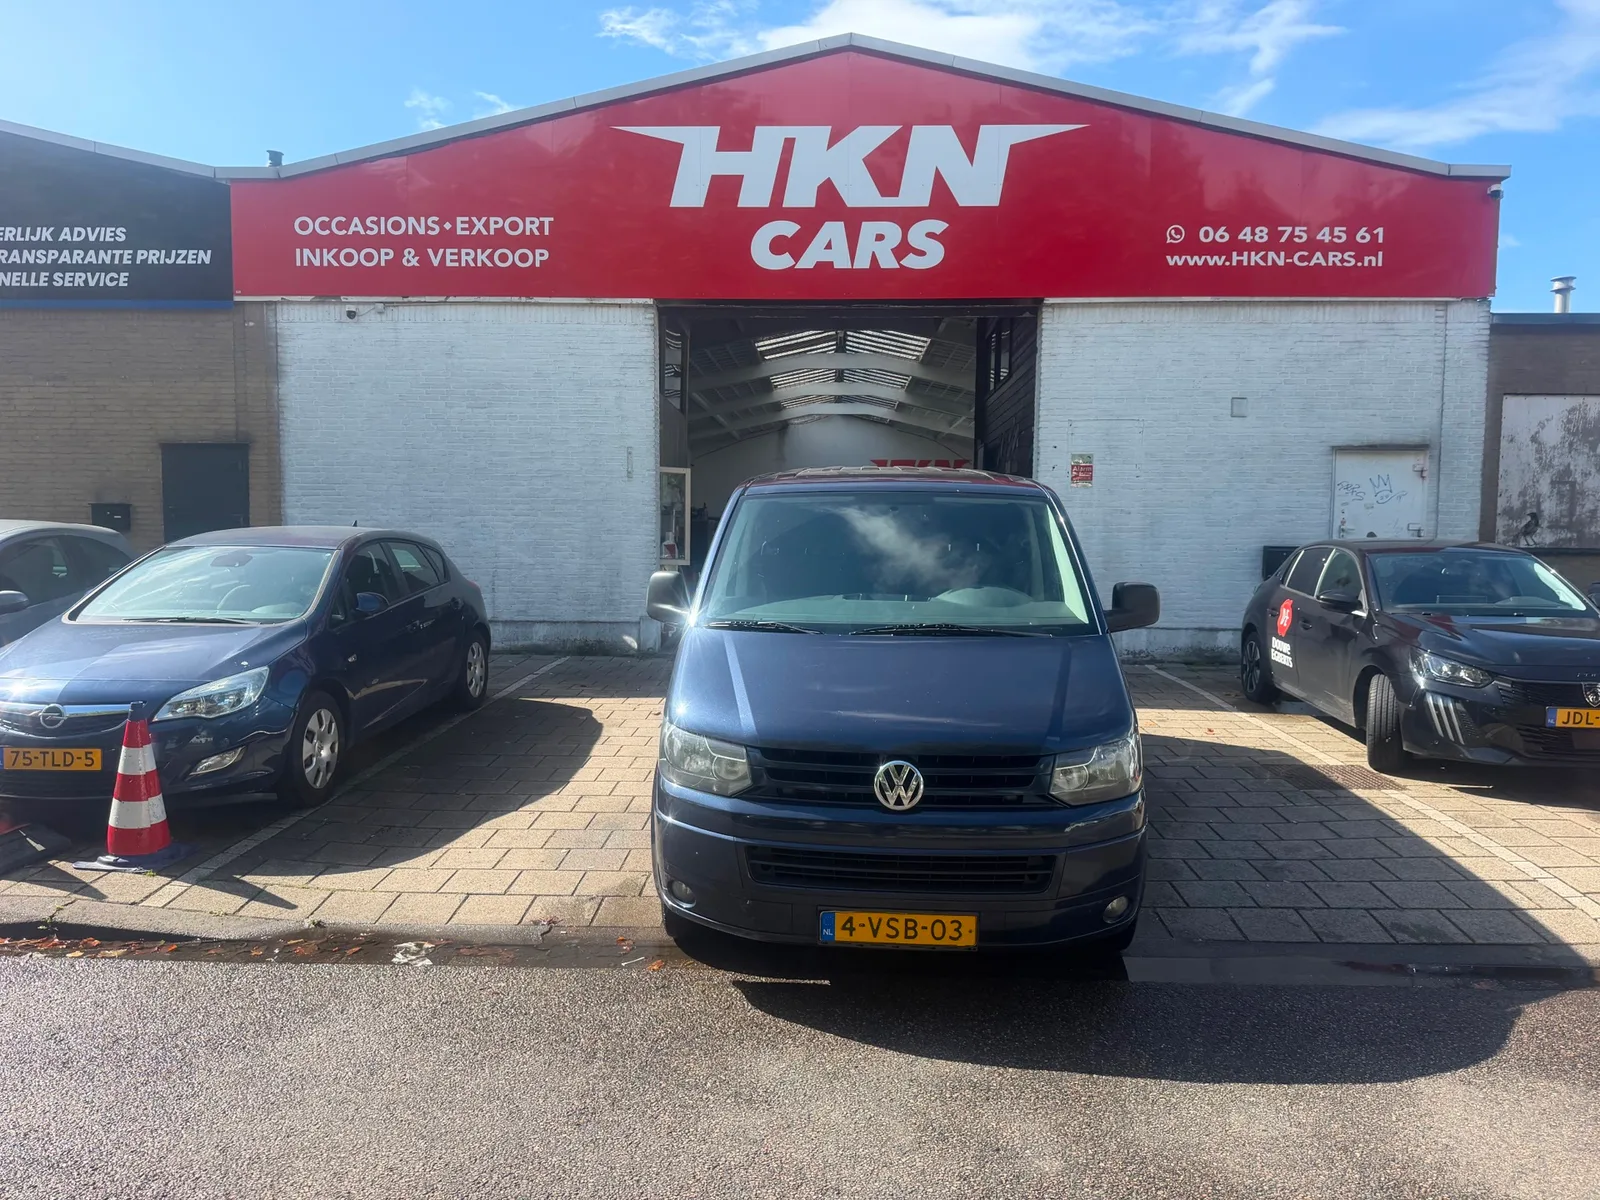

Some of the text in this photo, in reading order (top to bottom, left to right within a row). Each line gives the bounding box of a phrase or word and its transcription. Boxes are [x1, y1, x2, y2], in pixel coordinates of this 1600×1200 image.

[609, 124, 1091, 207] HKN
[58, 226, 127, 242] ADVIES
[293, 215, 554, 236] OCCASIONS EXPORT
[1199, 226, 1384, 243] 06 48 75 45 61
[750, 218, 949, 270] CARS
[0, 249, 212, 265] RANSPARANTE PRIJZEN
[295, 247, 550, 268] INKOOP & VERKOOP
[1166, 250, 1383, 267] www.HKN-CARS.nl
[0, 271, 130, 287] NELLE SERVICE
[10, 750, 95, 767] 75-TLD-5
[822, 915, 963, 941] NL 4-VSB-03
